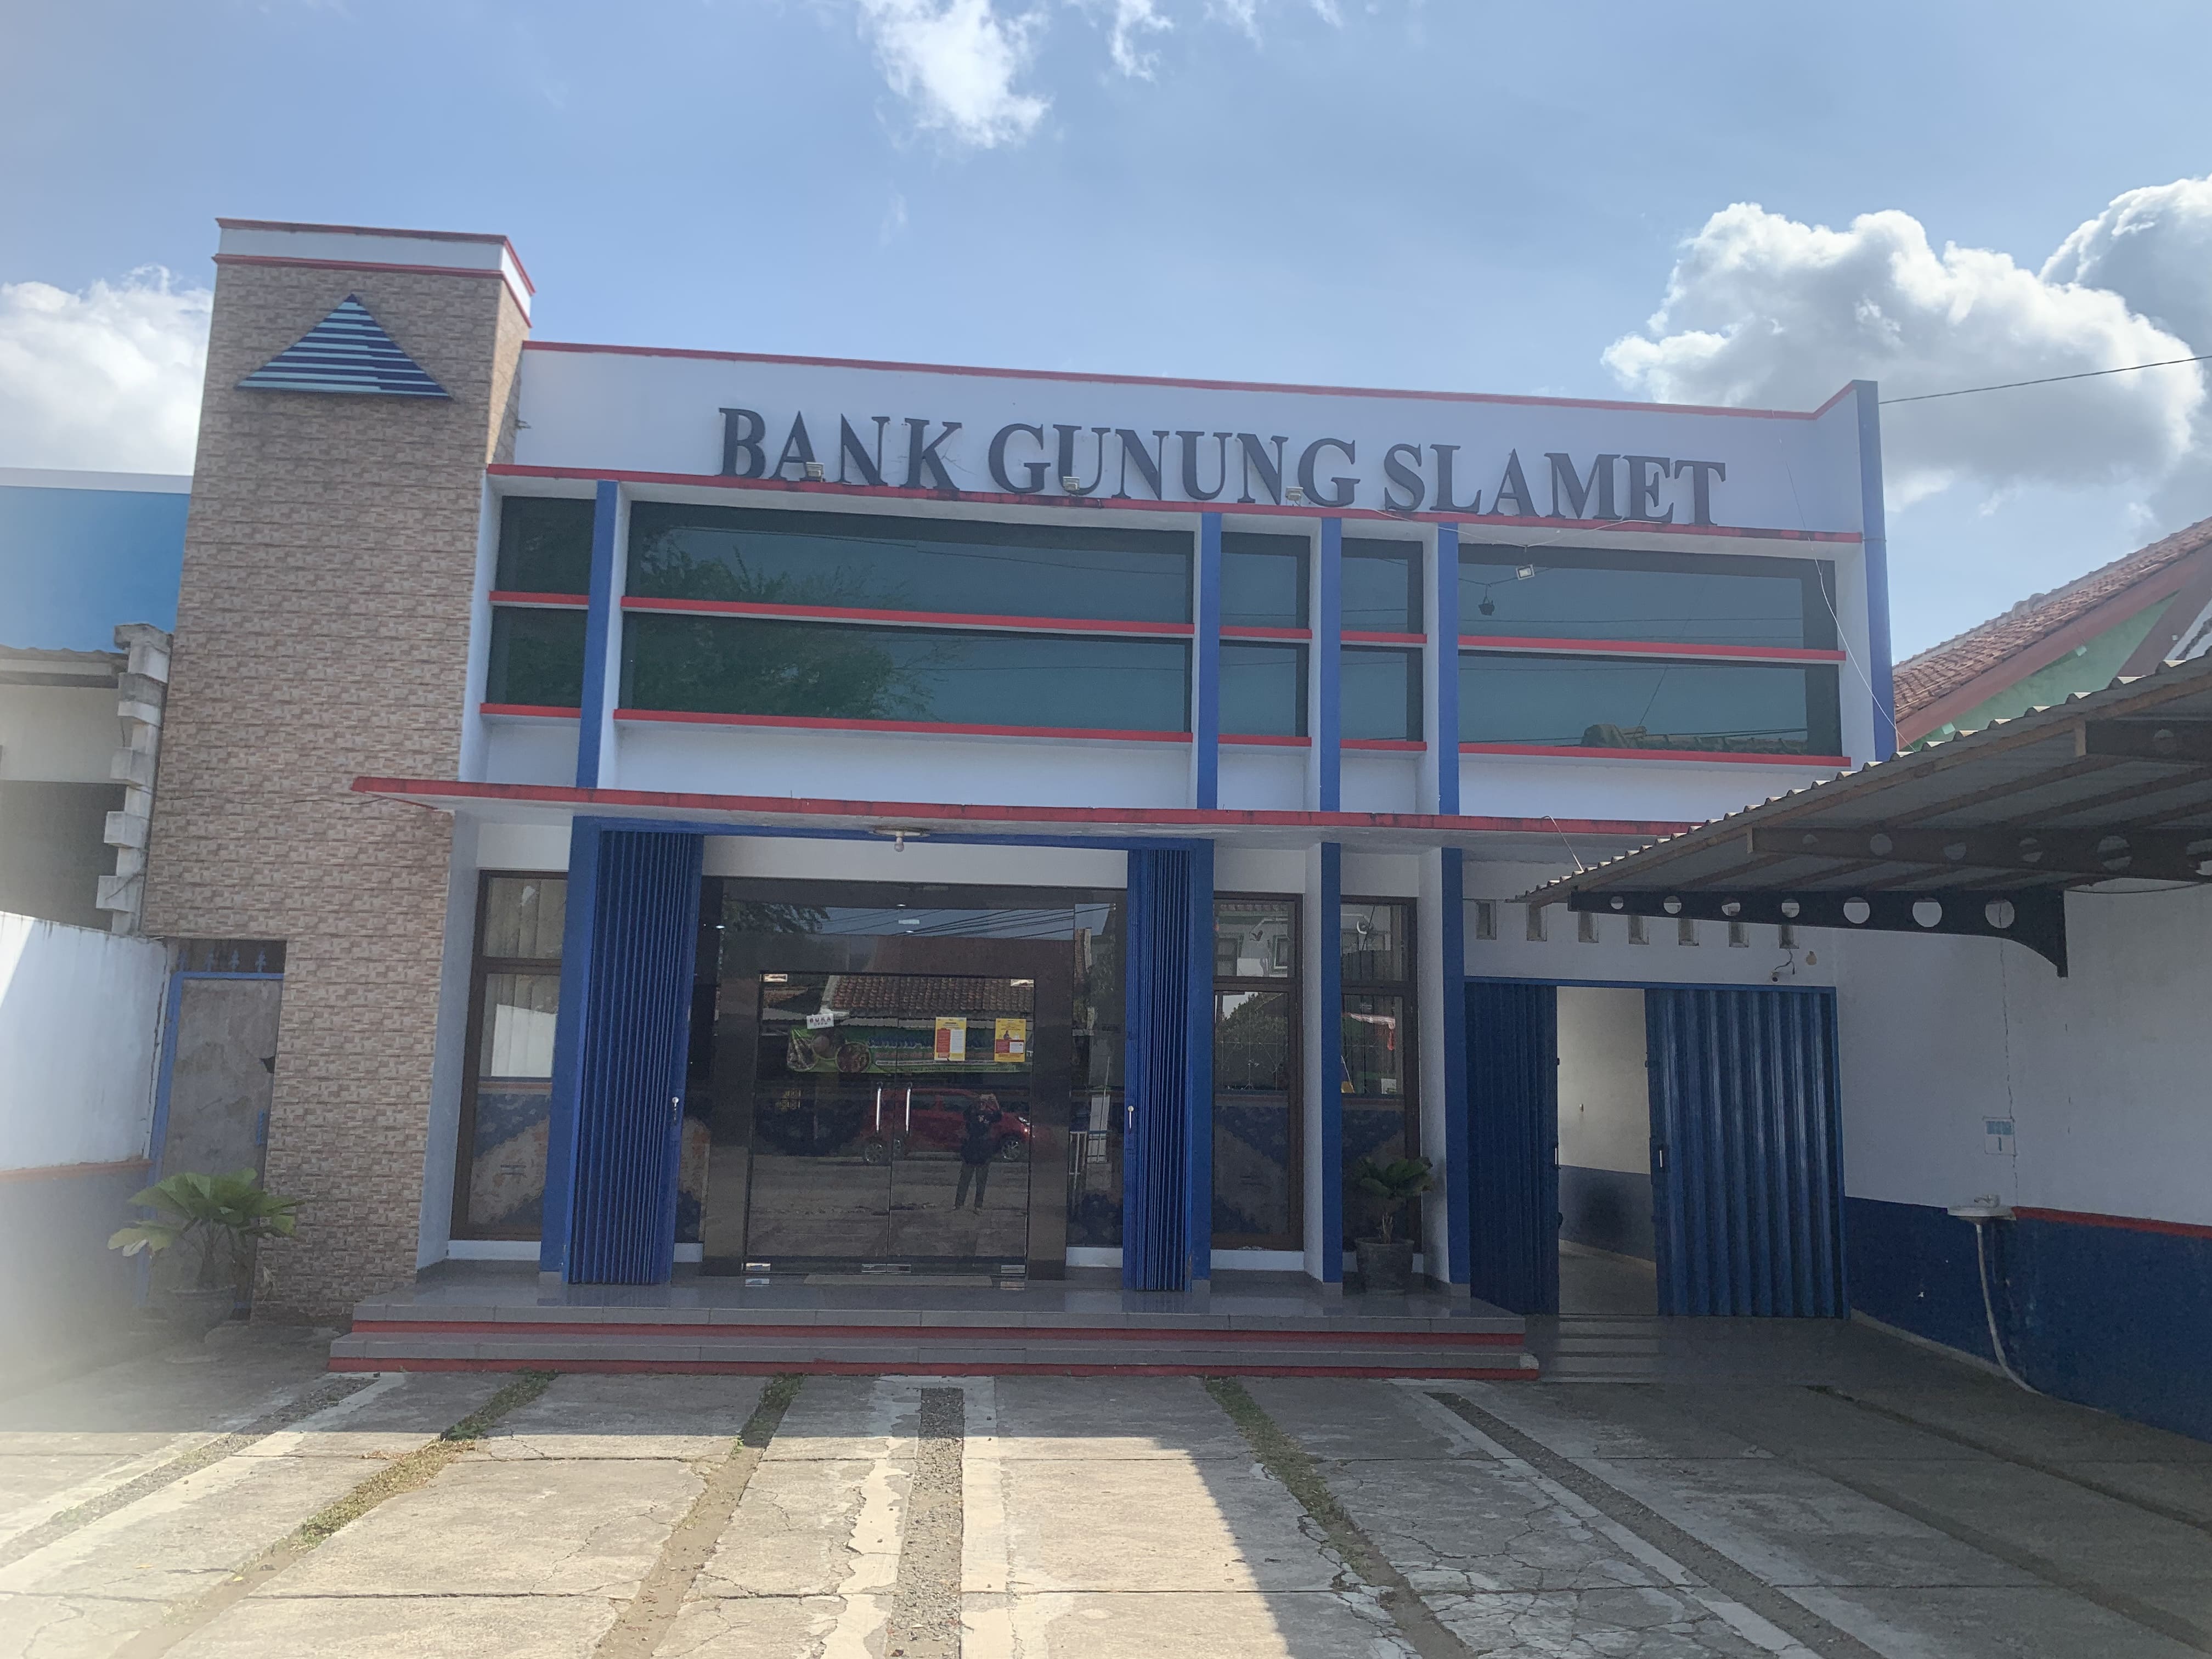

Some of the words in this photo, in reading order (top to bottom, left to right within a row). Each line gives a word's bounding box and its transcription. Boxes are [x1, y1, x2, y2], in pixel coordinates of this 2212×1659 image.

[719, 408, 962, 490] BANK
[988, 422, 1361, 508] GUNUNG
[1384, 443, 1726, 525] SLAMET
